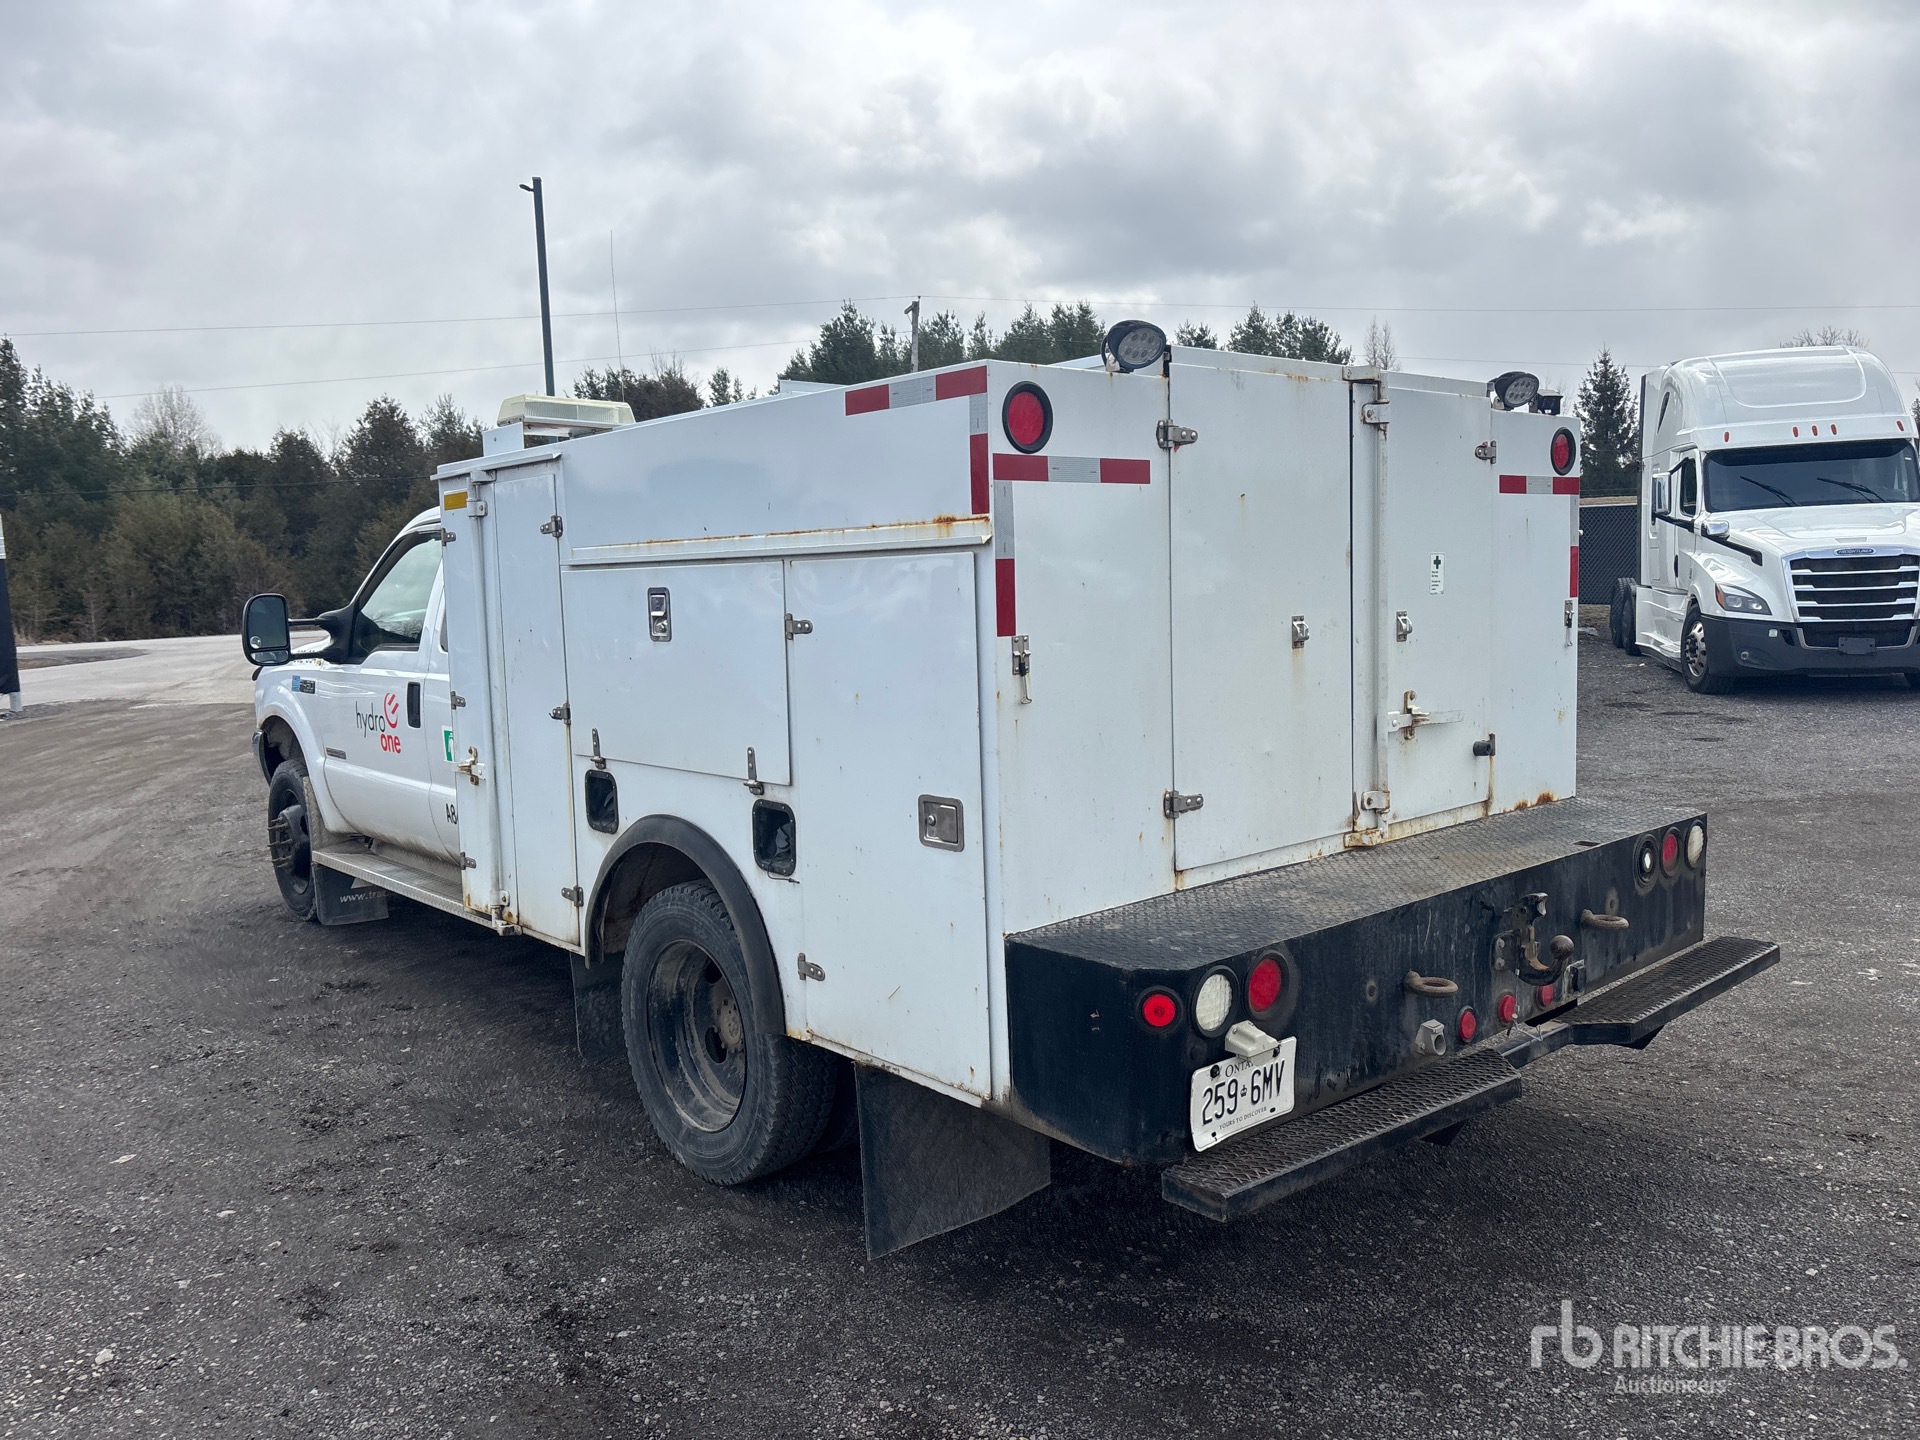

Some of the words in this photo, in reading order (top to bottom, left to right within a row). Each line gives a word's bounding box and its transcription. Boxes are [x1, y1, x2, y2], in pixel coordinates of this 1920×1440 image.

[355, 701, 386, 738] hydro
[380, 733, 402, 754] one
[445, 803, 459, 825] A8
[1225, 1059, 1254, 1078] ONTA
[1202, 1078, 1239, 1126] 259
[1251, 1060, 1285, 1105] 6MV
[1219, 1118, 1236, 1130] YOURS
[1236, 1116, 1243, 1124] TO
[1243, 1106, 1267, 1120] DISCOVER
